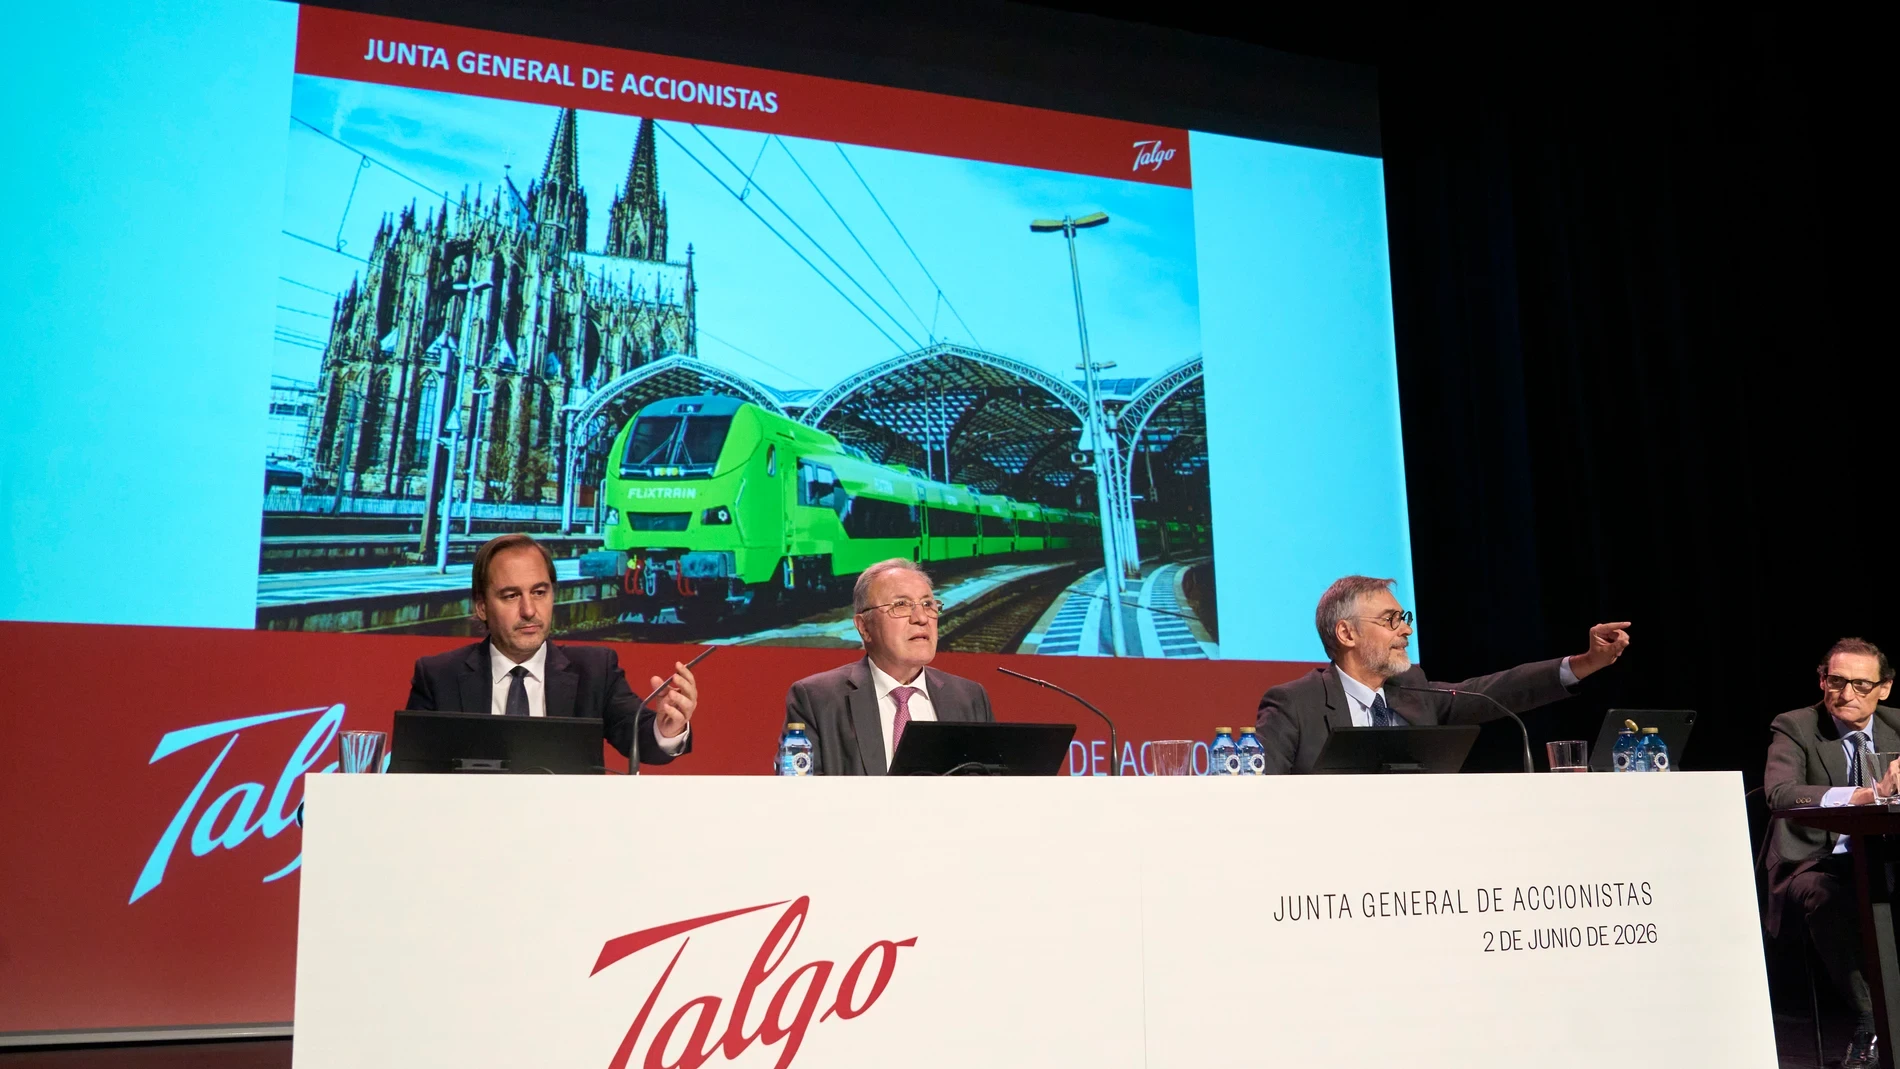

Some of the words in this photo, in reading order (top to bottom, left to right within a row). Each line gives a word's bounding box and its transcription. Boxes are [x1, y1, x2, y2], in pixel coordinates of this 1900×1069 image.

[364, 38, 450, 71] JUNTA
[457, 50, 575, 87] GENERAL
[582, 67, 614, 92] DE
[621, 73, 778, 114] ACCIONISTAS
[1132, 140, 1177, 172] Talgo
[1069, 740, 1109, 776] DE
[128, 703, 391, 906] Tal
[1273, 893, 1353, 922] JUNTA
[1362, 889, 1469, 918] GENERAL
[1477, 887, 1505, 913] DE
[1512, 881, 1653, 912] ACCIONISTAS
[1483, 930, 1495, 953] 2
[1499, 929, 1524, 952] DE
[1527, 926, 1582, 950] JUNIO
[1586, 925, 1610, 947] DE
[1613, 922, 1658, 946] 2026
[588, 895, 919, 1069] Talgo
